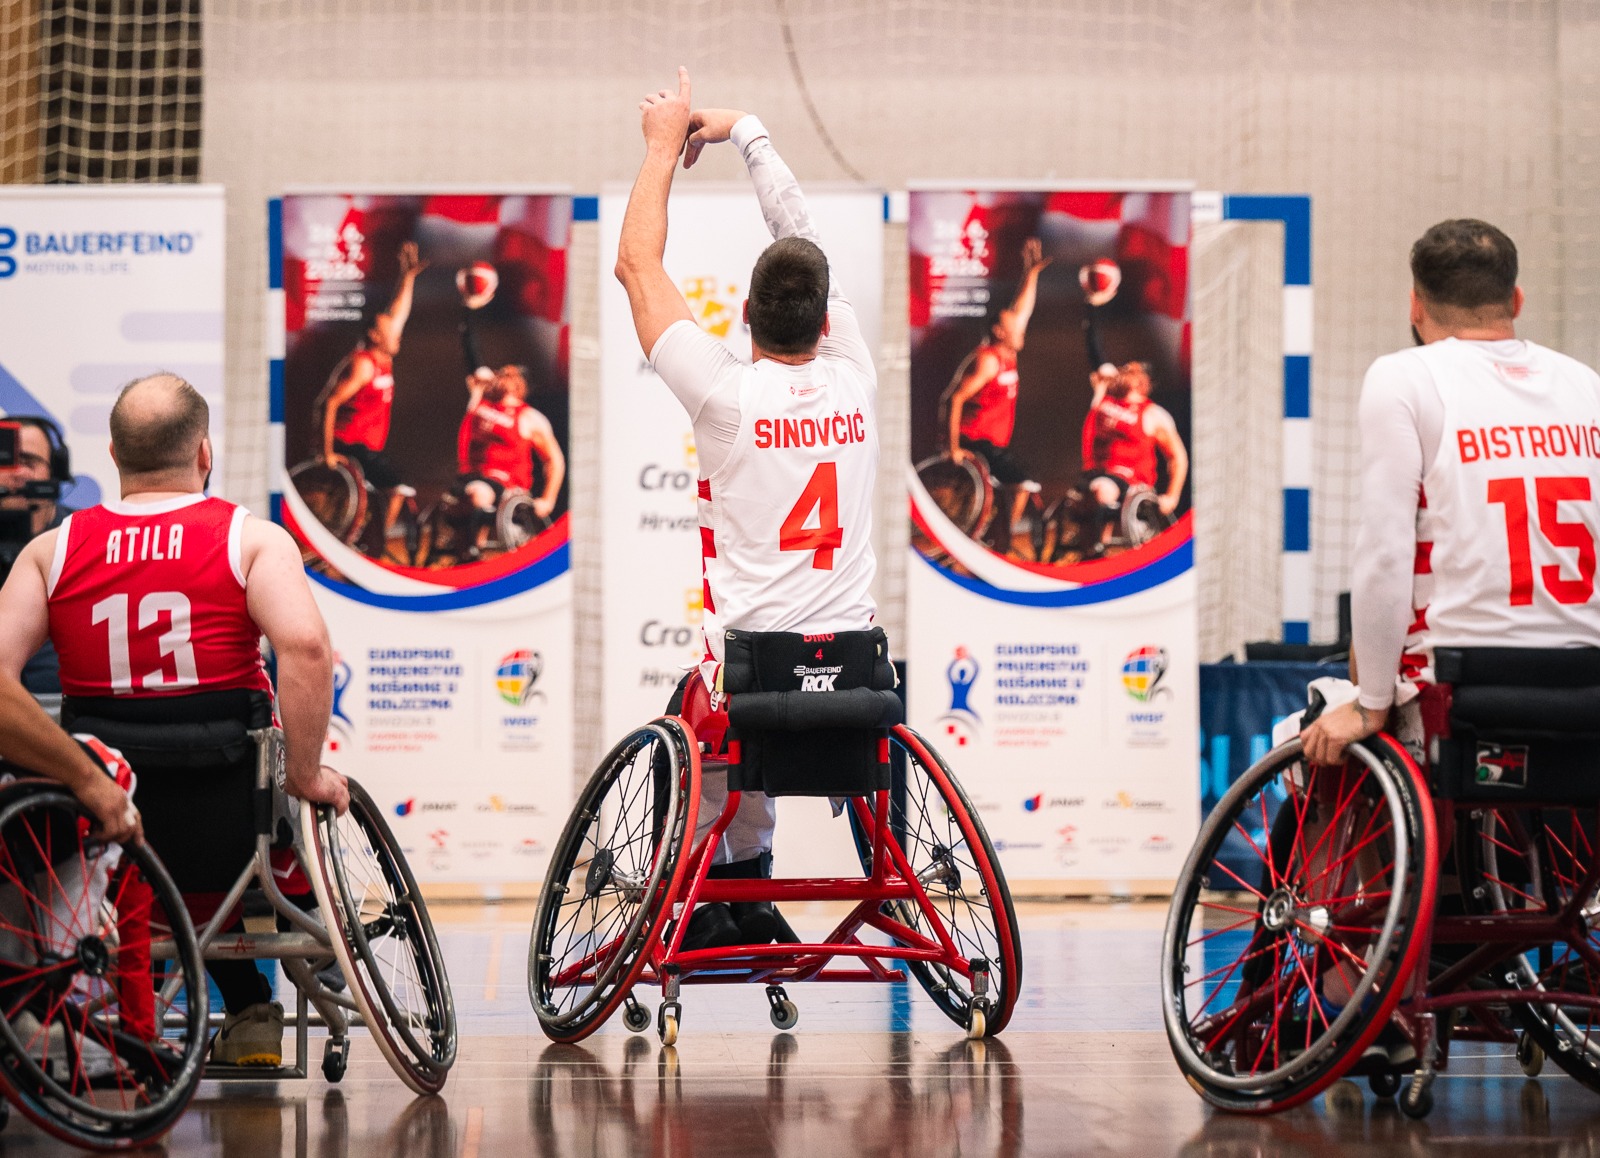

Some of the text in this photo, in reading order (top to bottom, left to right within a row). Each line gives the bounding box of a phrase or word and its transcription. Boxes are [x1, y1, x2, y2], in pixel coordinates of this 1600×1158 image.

[25, 232, 194, 254] BAUERFEIND
[755, 408, 865, 448] SINOVČIĆ
[780, 462, 843, 570] 4
[106, 524, 184, 564] ATILA
[1487, 476, 1596, 607] 15
[92, 591, 199, 695] 13
[815, 648, 823, 660] 4
